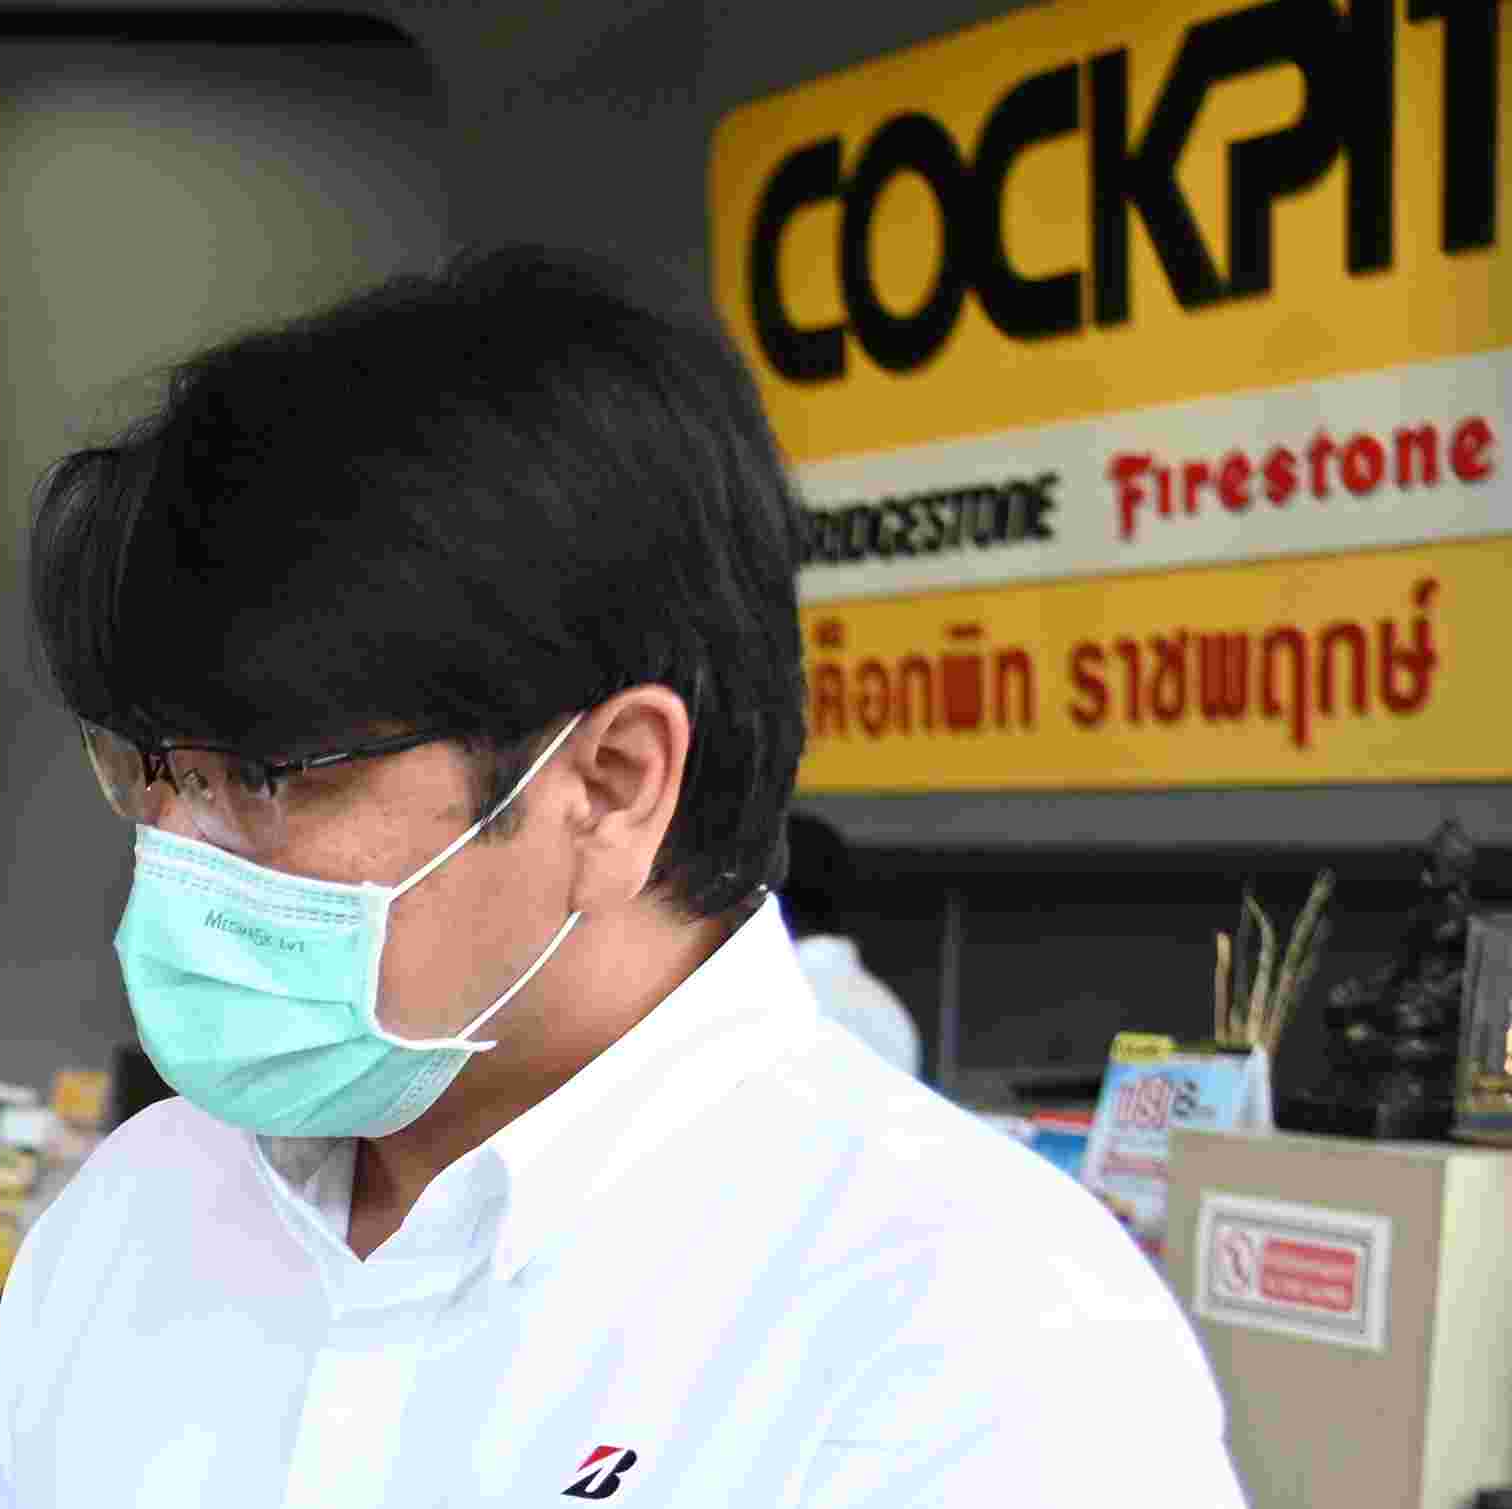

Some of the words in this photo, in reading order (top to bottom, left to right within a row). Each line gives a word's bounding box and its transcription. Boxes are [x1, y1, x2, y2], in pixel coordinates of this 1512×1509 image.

[746, 0, 1512, 384] COCKPIT
[1108, 414, 1495, 542] Firestone
[1067, 577, 1440, 750] ราชพฤกษ์
